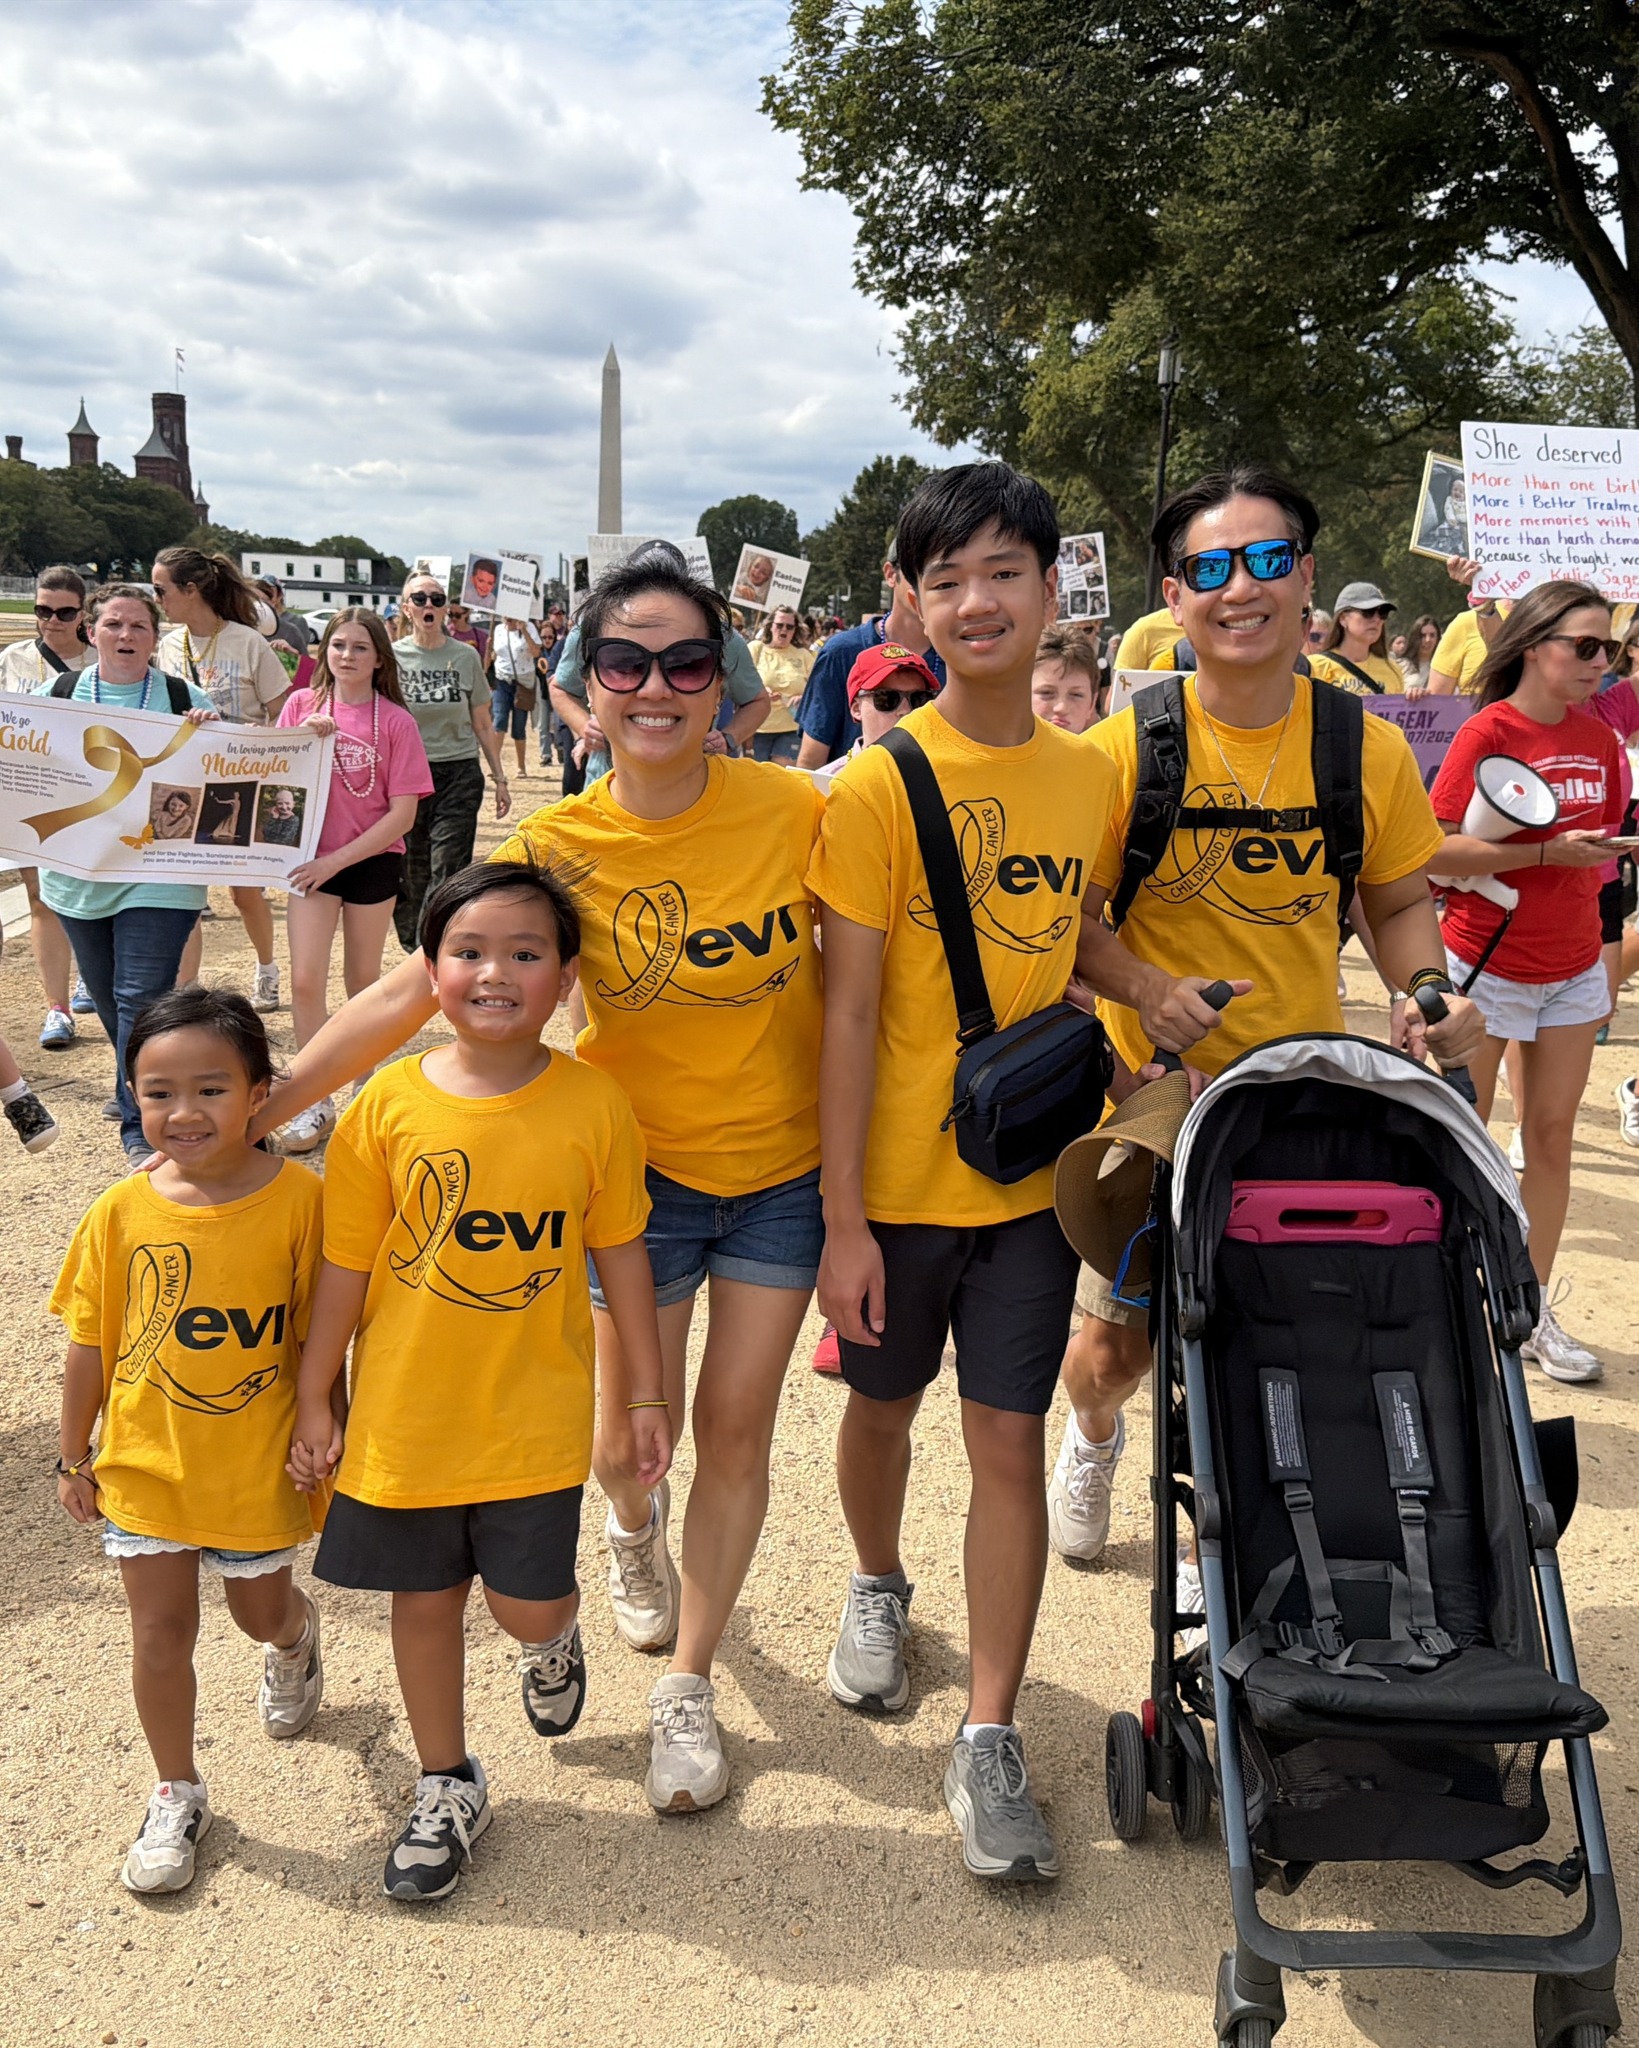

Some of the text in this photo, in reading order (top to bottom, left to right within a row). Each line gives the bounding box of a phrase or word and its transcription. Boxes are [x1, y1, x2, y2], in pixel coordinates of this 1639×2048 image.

[1473, 428, 1622, 464] She deserved
[1471, 472, 1511, 488] More
[1524, 474, 1560, 490] than
[1569, 481, 1595, 491] one
[1473, 494, 1510, 508] More
[1533, 494, 1576, 509] Better
[1474, 513, 1631, 529] More memories with
[1475, 531, 1510, 546] More
[1519, 531, 1551, 546] than
[1557, 530, 1594, 546] harsh
[1474, 547, 1532, 564] Because
[1540, 549, 1563, 564] she
[502, 573, 531, 587] Easton
[772, 580, 801, 594] Perrine
[774, 570, 803, 585] Easton
[1478, 569, 1531, 597] Our Hero
[501, 583, 531, 597] Perrine
[1, 710, 31, 729] We go
[0, 725, 52, 756] Gold
[226, 740, 313, 756] In loving memory of
[201, 752, 291, 779] Makayla
[981, 807, 999, 857] CANCER
[1170, 840, 1226, 899] CHILDHOOD
[623, 890, 680, 1006] CHILDHOOD CANCER
[411, 1159, 460, 1280] CHILDHOOD CANCER
[125, 1252, 180, 1376] CHILDHOOD CANCER
[1266, 1381, 1281, 1461] WARNING/ADVERTENCIA
[1403, 1409, 1412, 1424] MISE
[1406, 1424, 1415, 1436] EN
[1408, 1435, 1420, 1460] GARDE
